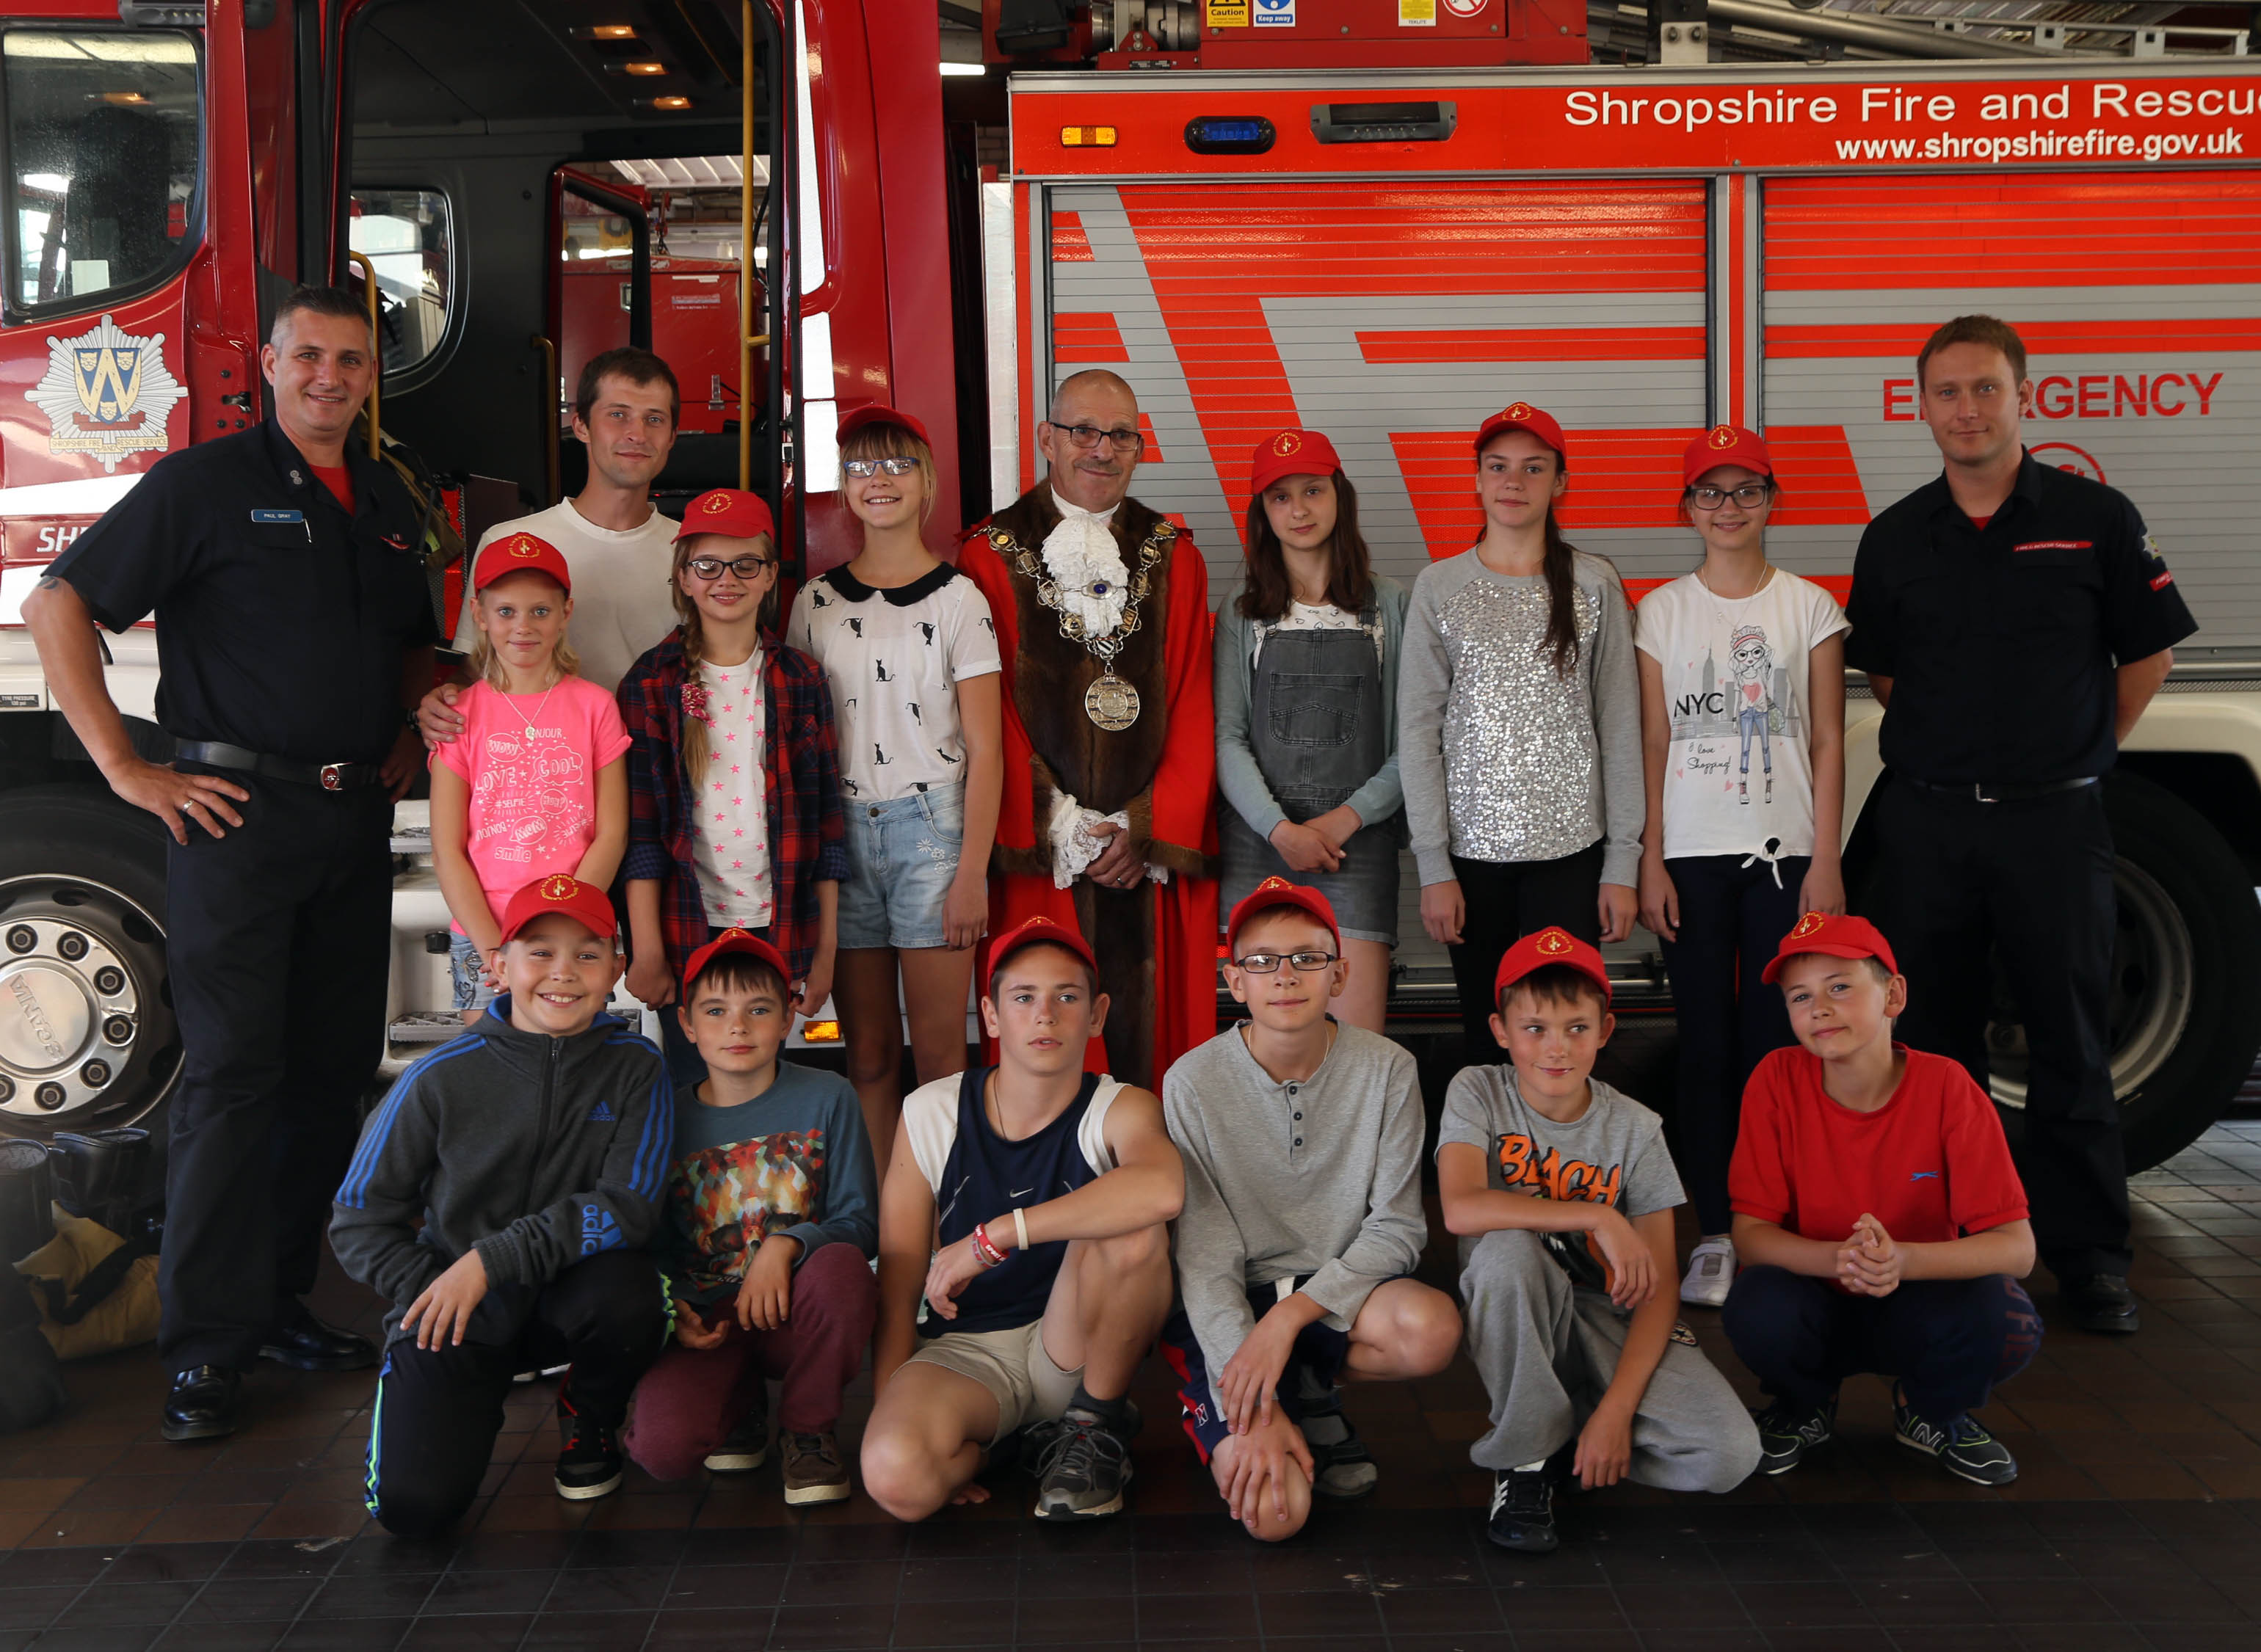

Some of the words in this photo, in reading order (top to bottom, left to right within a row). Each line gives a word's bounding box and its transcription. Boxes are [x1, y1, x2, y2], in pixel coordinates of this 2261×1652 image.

[1564, 88, 1837, 133] Shropshire
[1861, 87, 1956, 123] Fire
[1979, 84, 2069, 121] and
[2093, 83, 2261, 119] Rescu
[1835, 127, 2243, 164] www.shropshirefire.gov.uk
[1883, 372, 2224, 422] EGENCY
[36, 526, 90, 553] SH
[1674, 693, 1724, 717] NYC
[1697, 743, 1715, 754] love
[539, 756, 578, 776] COOL
[494, 845, 532, 863] smile
[10, 974, 64, 1063] SCANIA
